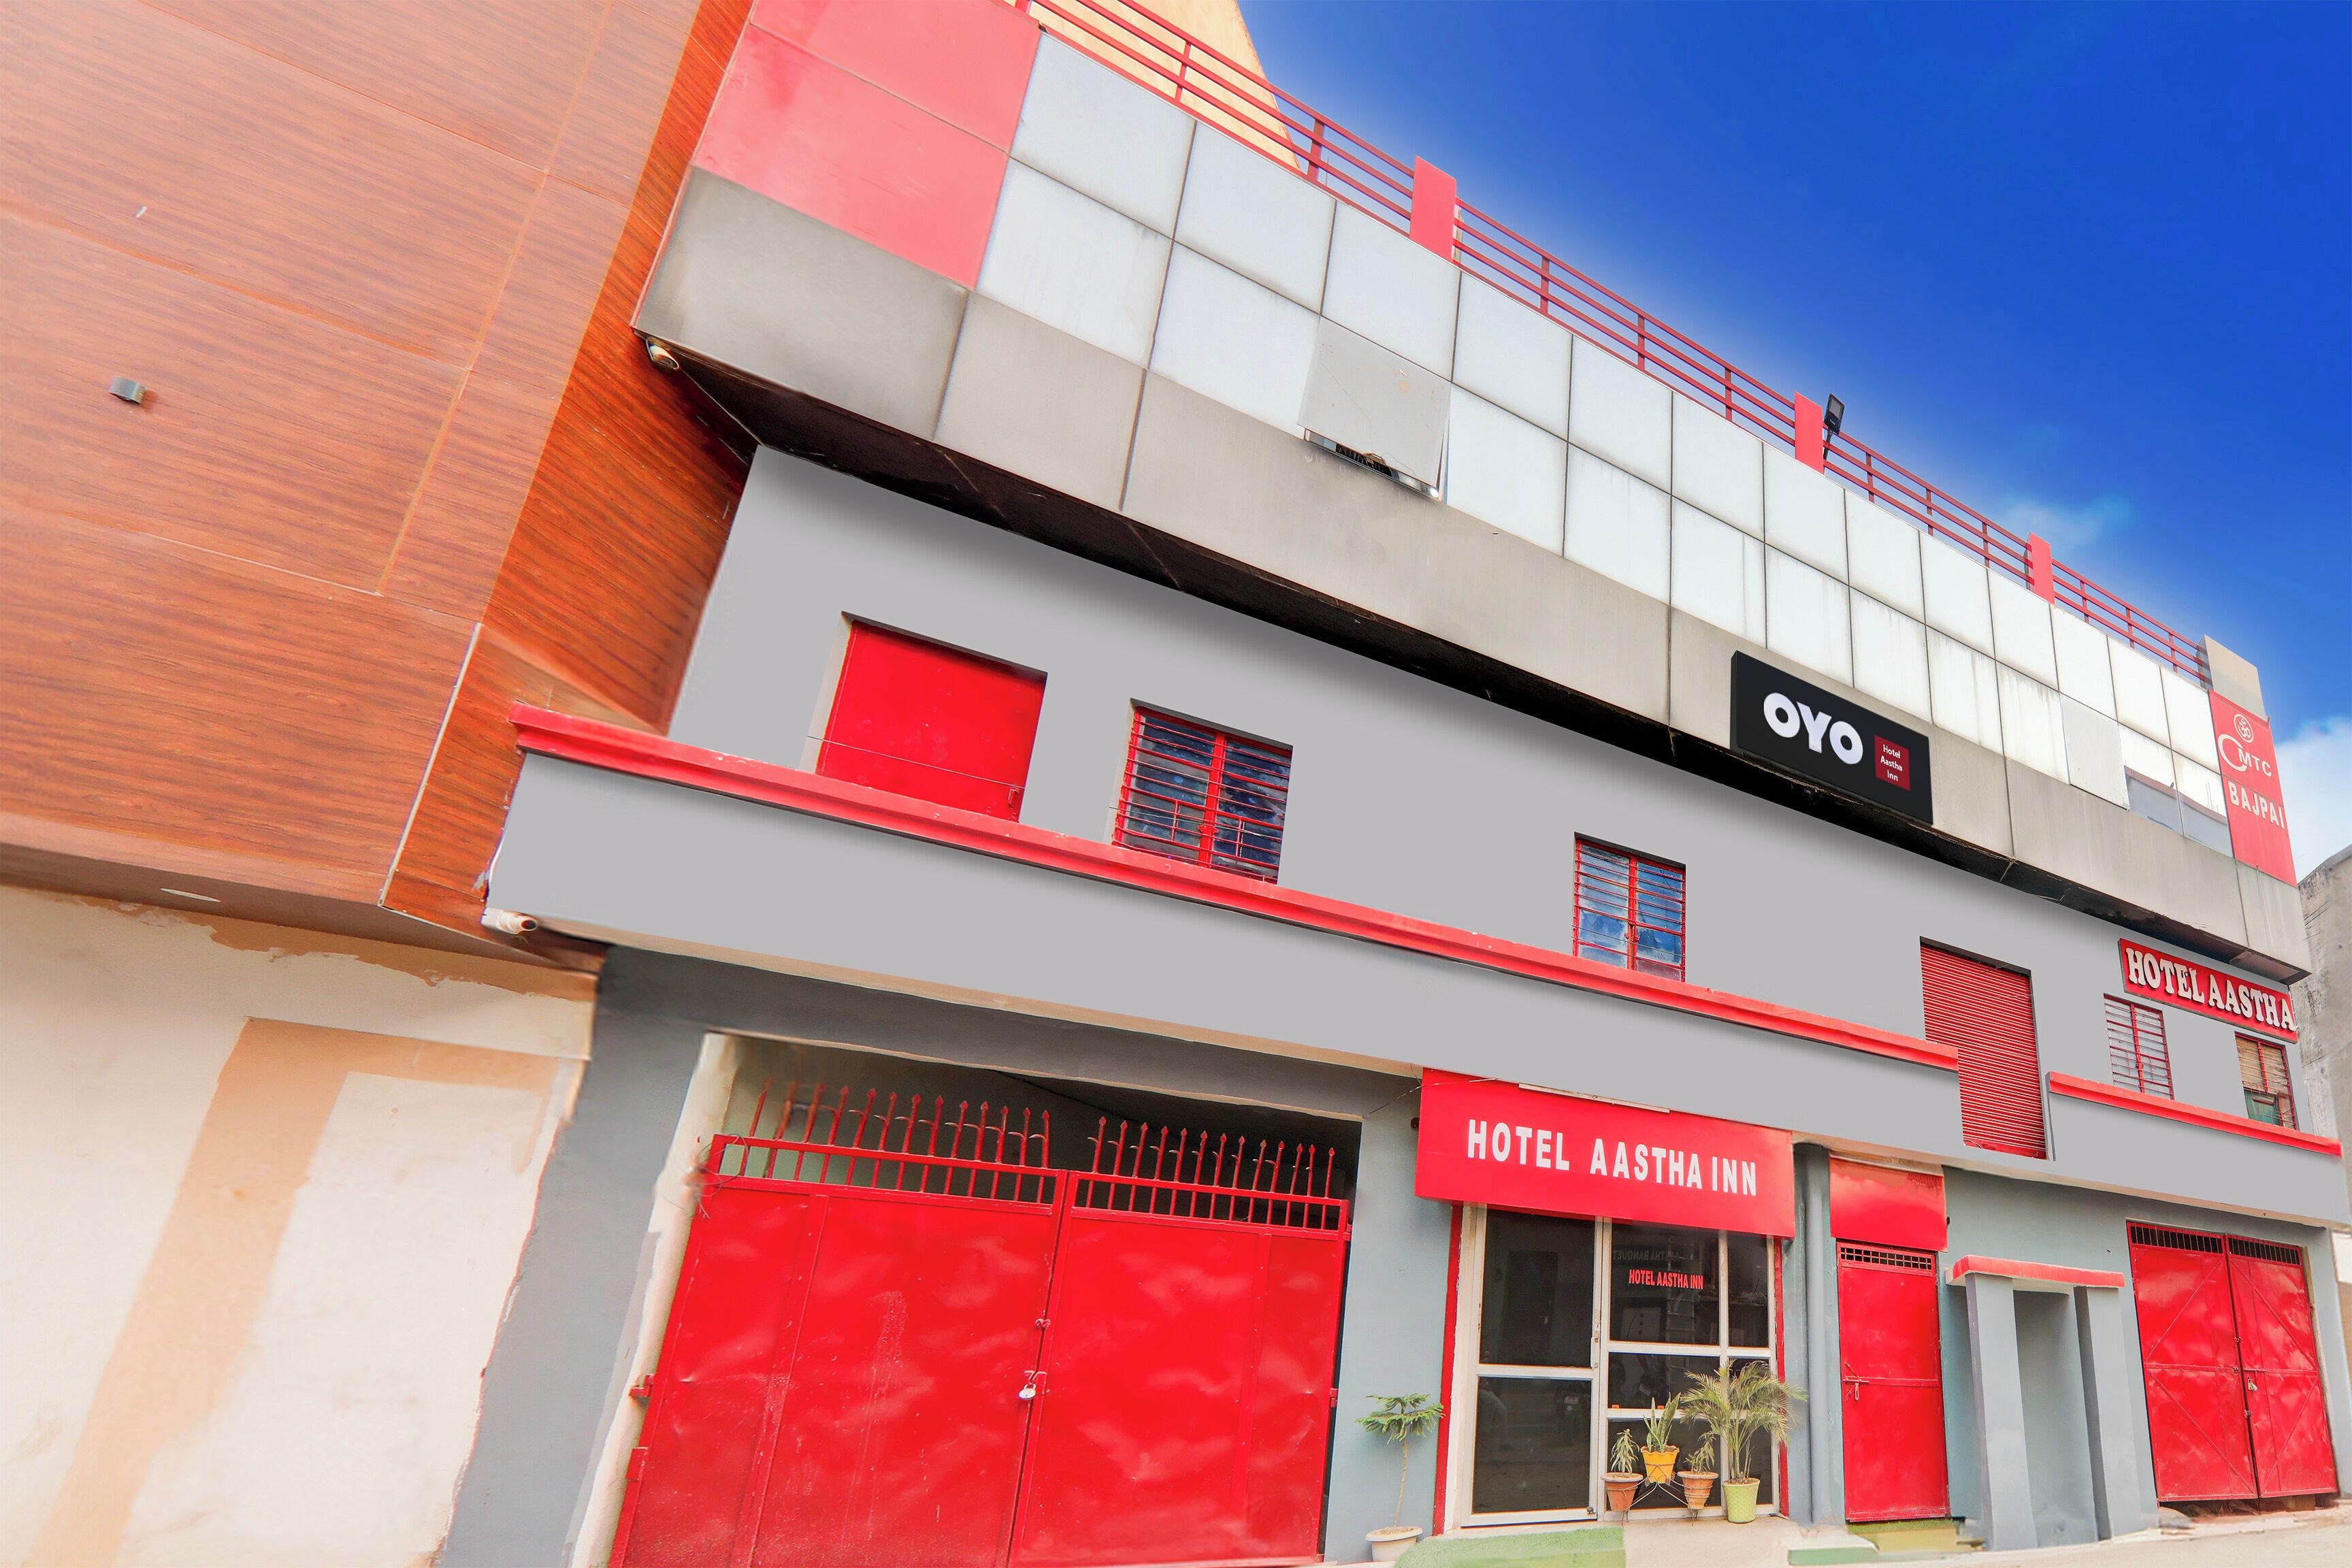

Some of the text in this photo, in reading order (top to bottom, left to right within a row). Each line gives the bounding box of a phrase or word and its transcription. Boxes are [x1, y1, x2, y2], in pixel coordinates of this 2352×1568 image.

[1763, 692, 1863, 764] OYO
[1880, 755, 1903, 772] Aastha
[1882, 744, 1901, 759] Hotel
[1886, 770, 1899, 782] Inn
[2227, 780, 2285, 830] BAJPAI
[2125, 947, 2298, 1032] HOTEL AASTHA
[1467, 1118, 1757, 1196] HOTEL AASTHA INN
[1629, 1269, 1703, 1290] HOTEL AASTHA INN
